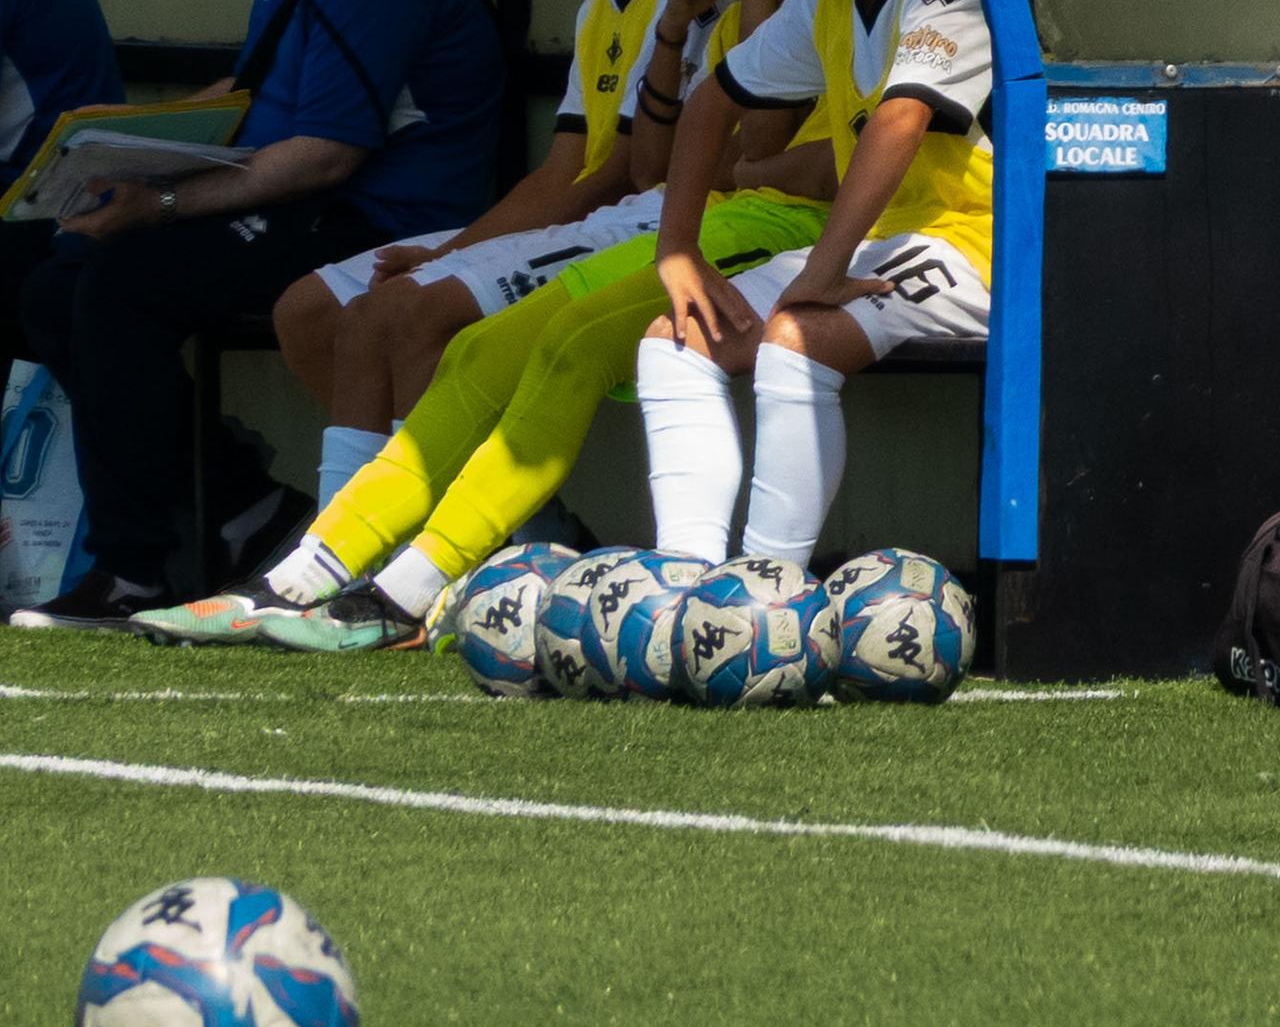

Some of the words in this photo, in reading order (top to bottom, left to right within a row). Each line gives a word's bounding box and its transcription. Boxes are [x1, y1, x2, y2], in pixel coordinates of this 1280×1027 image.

[1063, 102, 1119, 114] ROMAGNA
[1122, 102, 1166, 115] CENTRO
[1045, 122, 1150, 142] SQUADRA
[1056, 146, 1138, 166] LOCALE
[871, 244, 958, 305] 16
